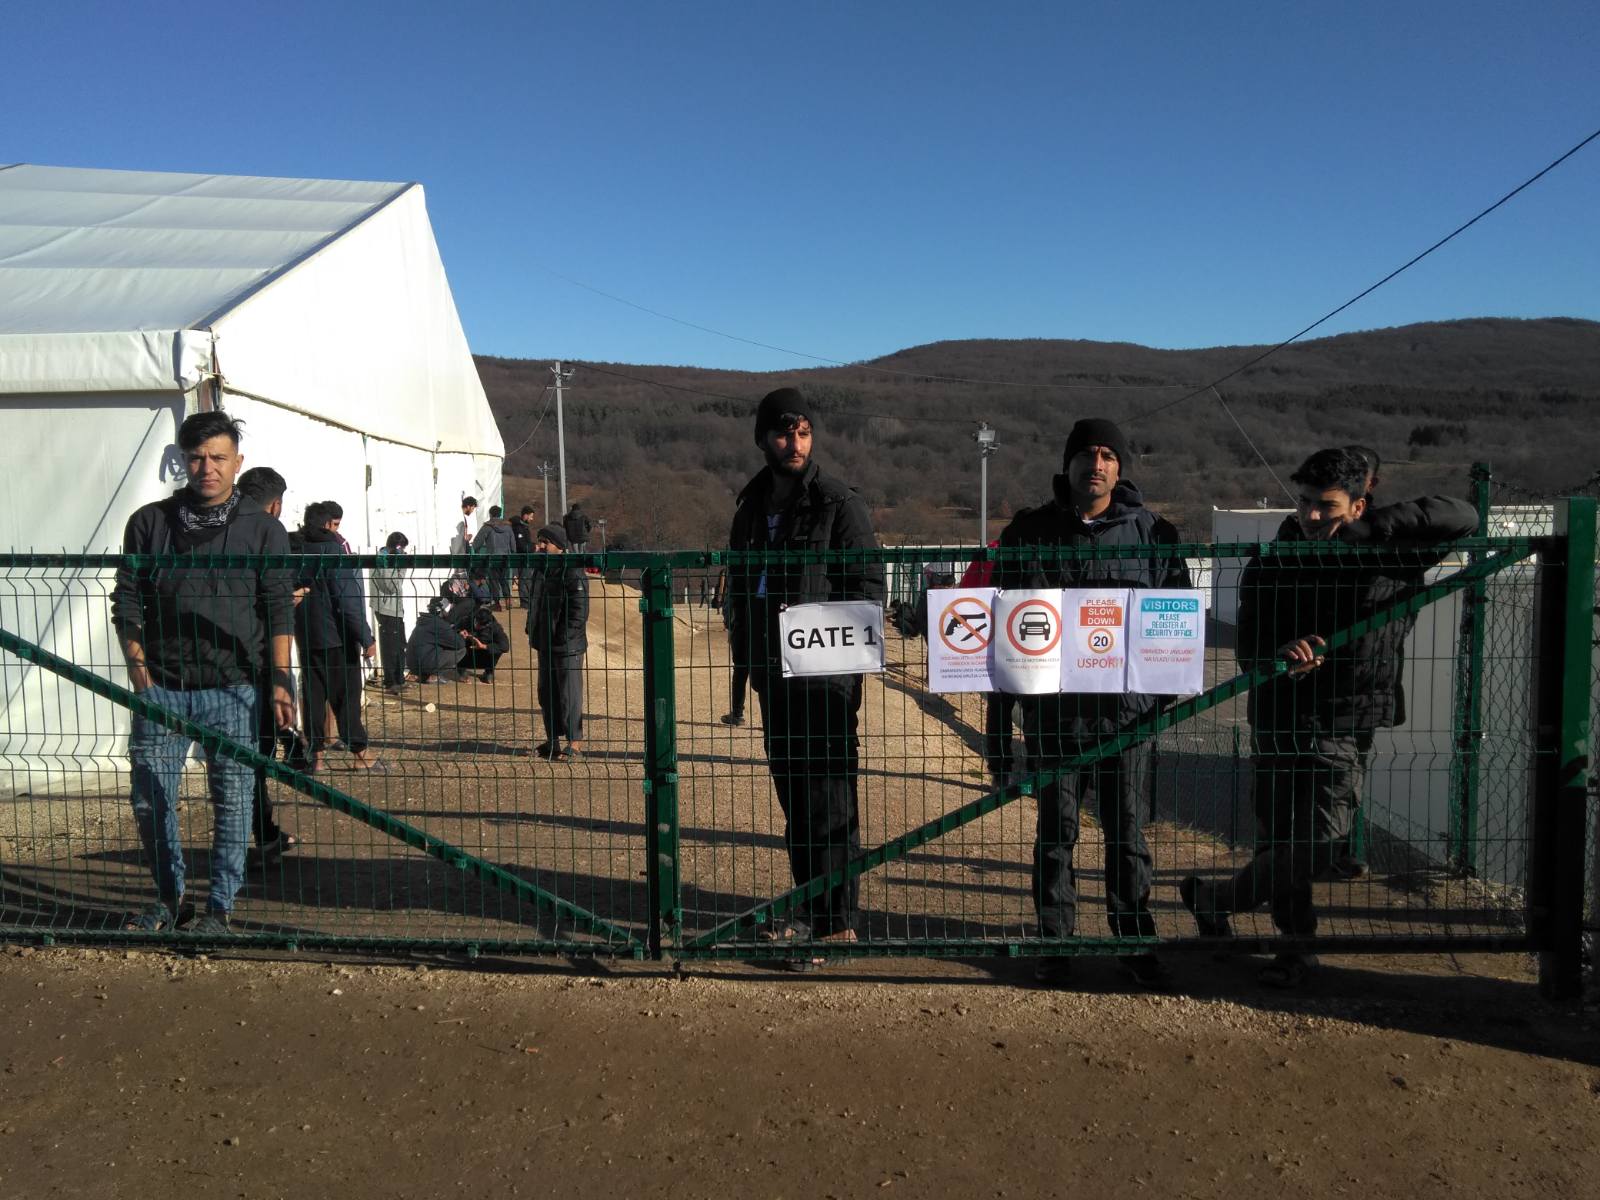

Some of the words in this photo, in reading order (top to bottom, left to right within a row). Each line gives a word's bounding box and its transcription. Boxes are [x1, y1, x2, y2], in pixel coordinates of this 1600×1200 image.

[1143, 599, 1196, 611] VISITORS
[1088, 607, 1115, 616] SLOW
[1088, 617, 1115, 625] DOWN
[1158, 613, 1180, 621] PLEASE
[1152, 621, 1179, 629] REGISTER
[1180, 621, 1187, 629] AT
[1145, 628, 1173, 637] SECURITY
[1173, 628, 1193, 637] OFFICE
[787, 626, 855, 650] GATE
[863, 625, 877, 646] 1
[1094, 636, 1109, 647] 20
